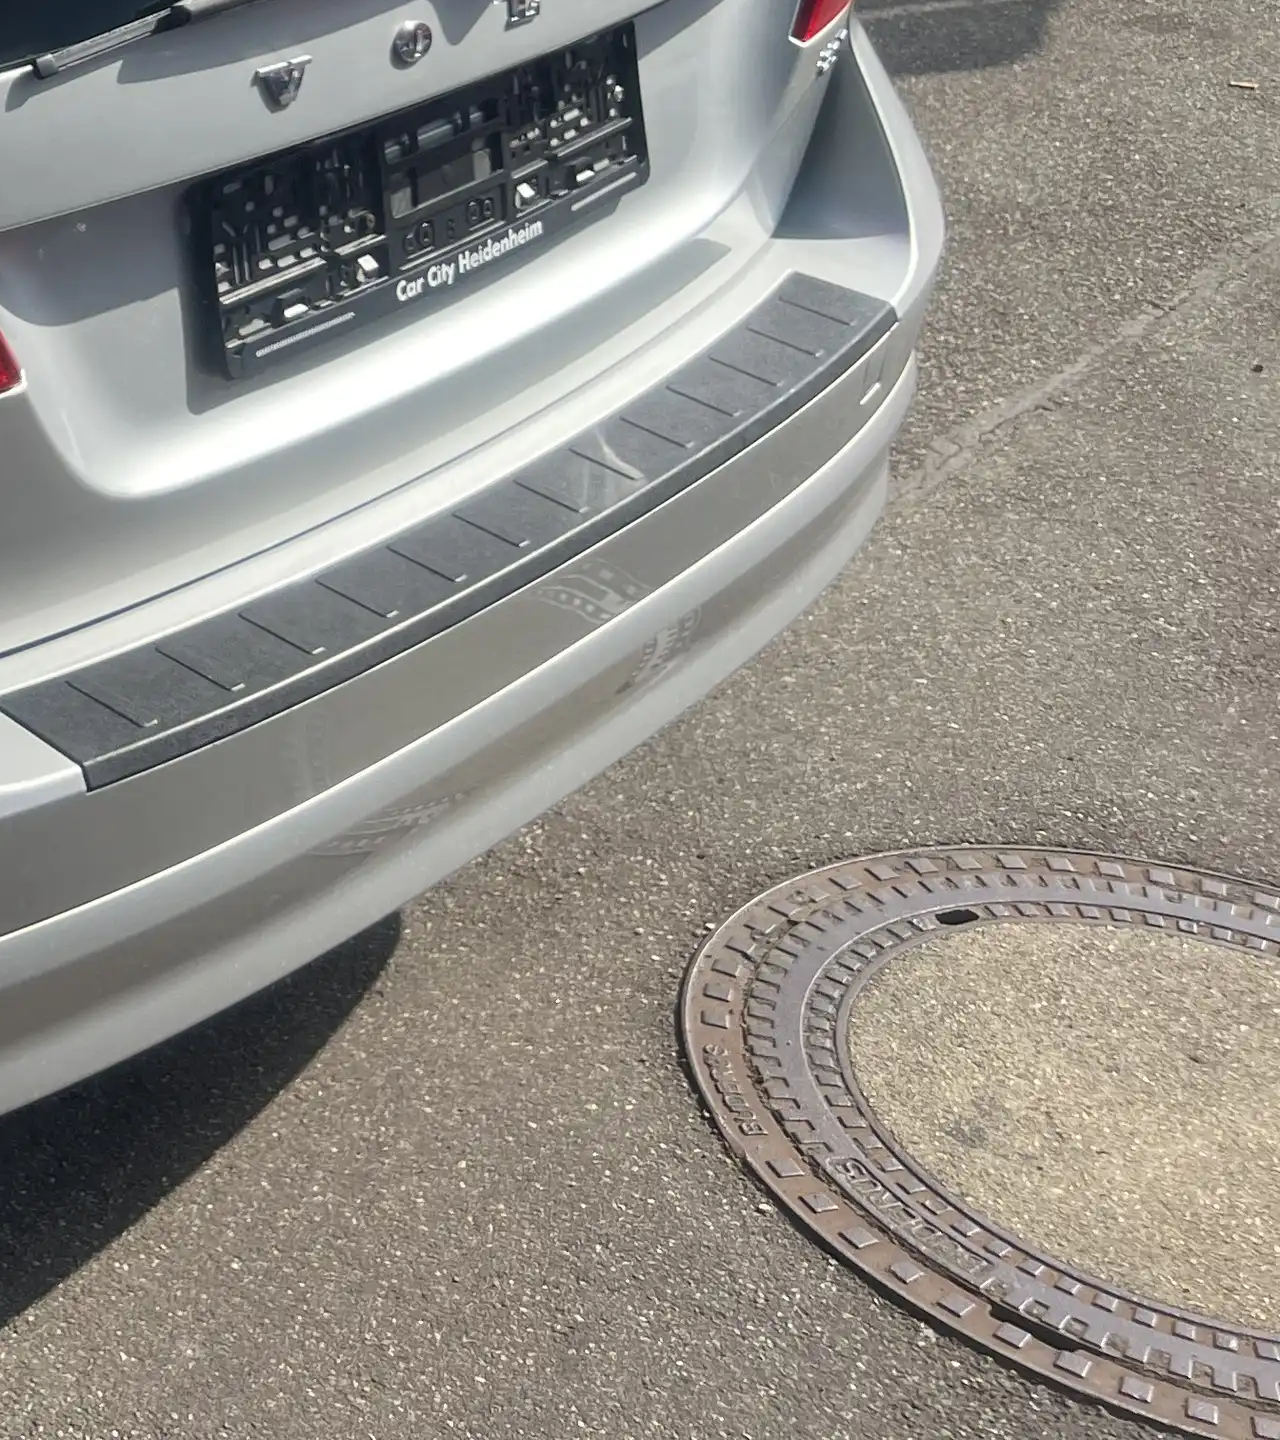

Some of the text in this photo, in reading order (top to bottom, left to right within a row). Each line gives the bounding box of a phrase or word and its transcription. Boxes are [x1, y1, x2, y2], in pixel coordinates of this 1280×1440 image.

[395, 220, 544, 302] Car City Heidenheim
